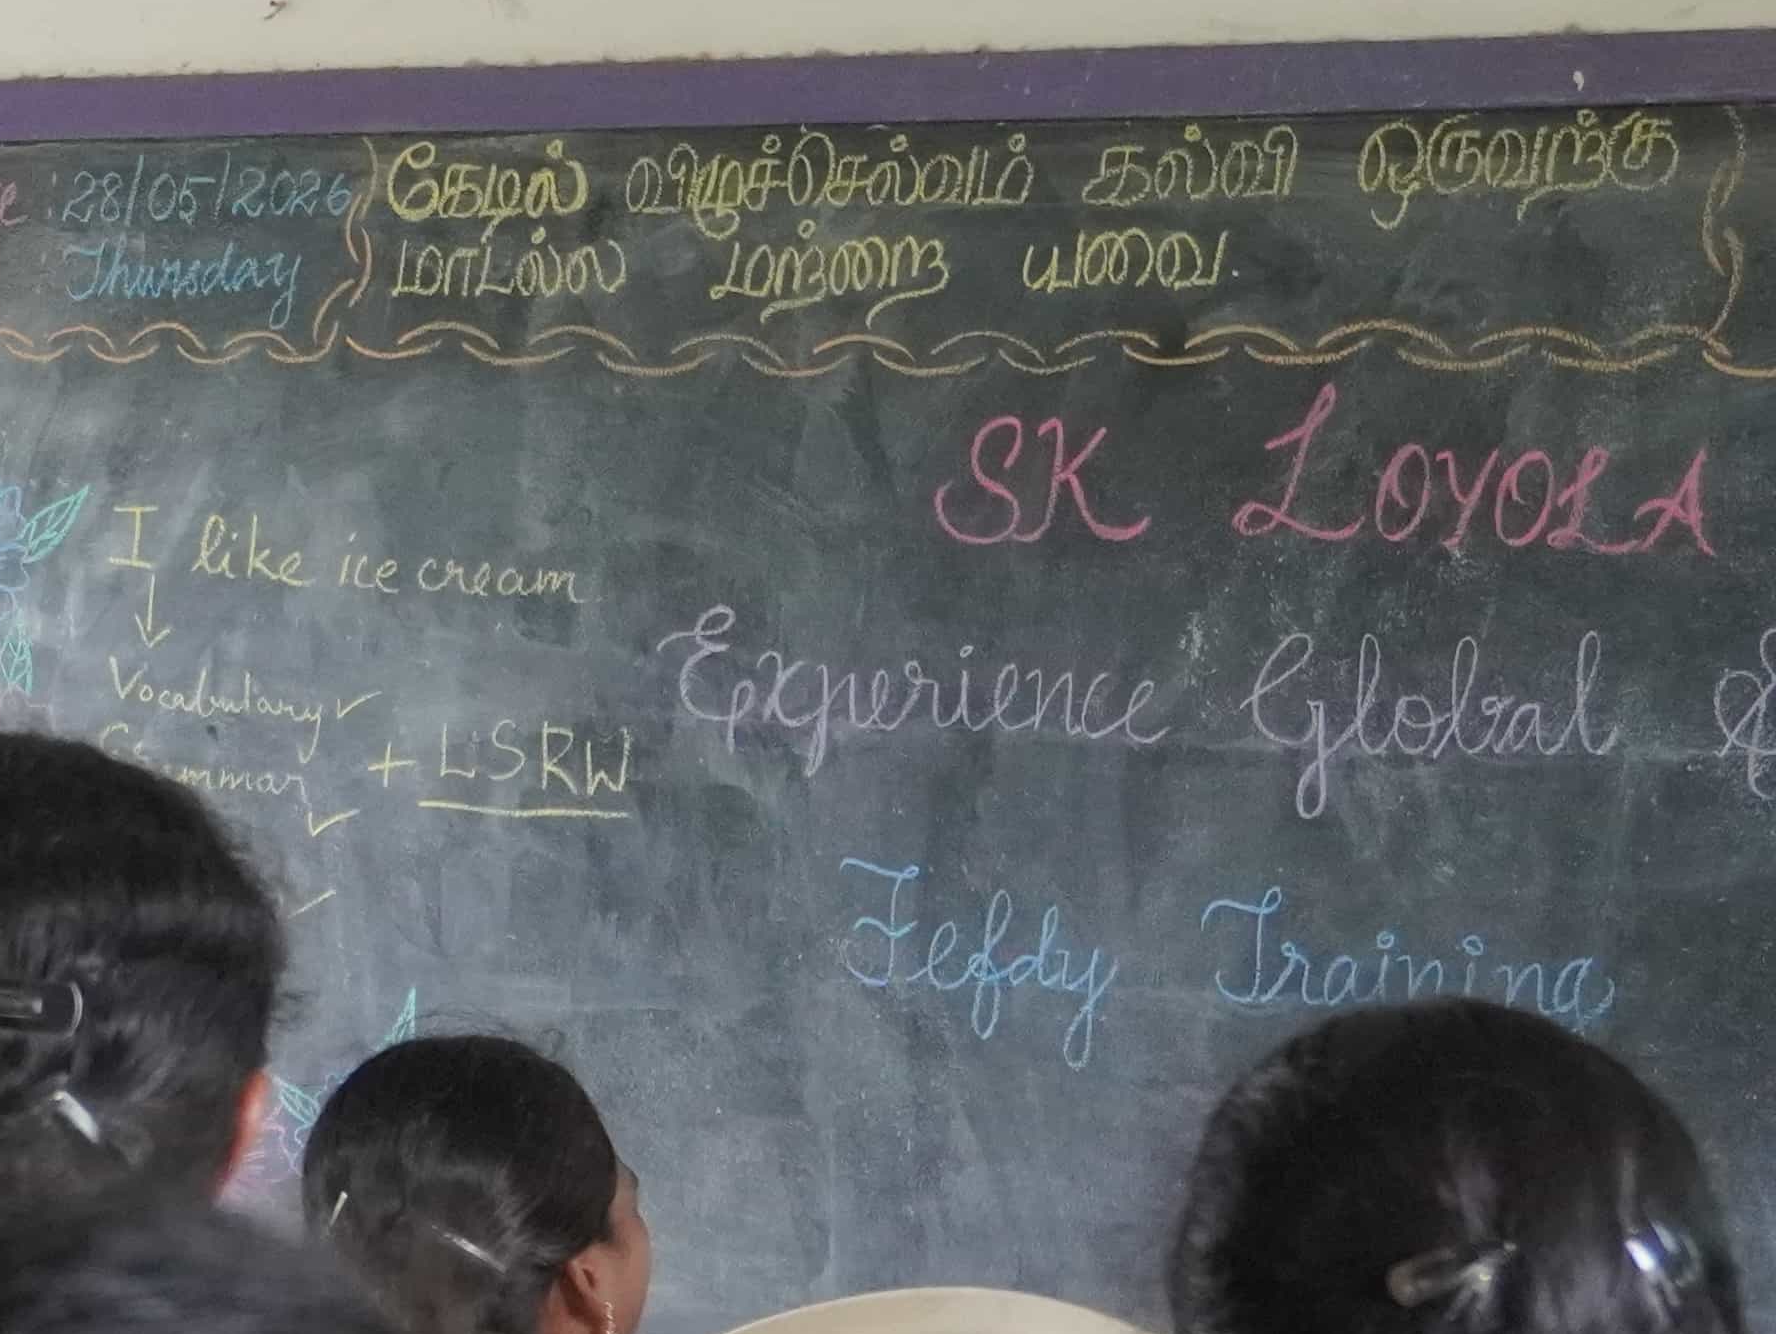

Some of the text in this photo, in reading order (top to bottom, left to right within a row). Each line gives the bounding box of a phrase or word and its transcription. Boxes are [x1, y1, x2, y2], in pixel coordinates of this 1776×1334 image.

[61, 151, 351, 227] 28/05/2026
[1081, 123, 1299, 208] கல்வி
[62, 232, 304, 331] Thursday
[934, 381, 1716, 557] SK LOYOLA
[108, 505, 590, 605] I like ice cream
[108, 654, 324, 765] Vocabulary
[439, 718, 630, 796] LSRW
[656, 603, 1172, 779] Experience
[1238, 629, 1620, 820] Global
